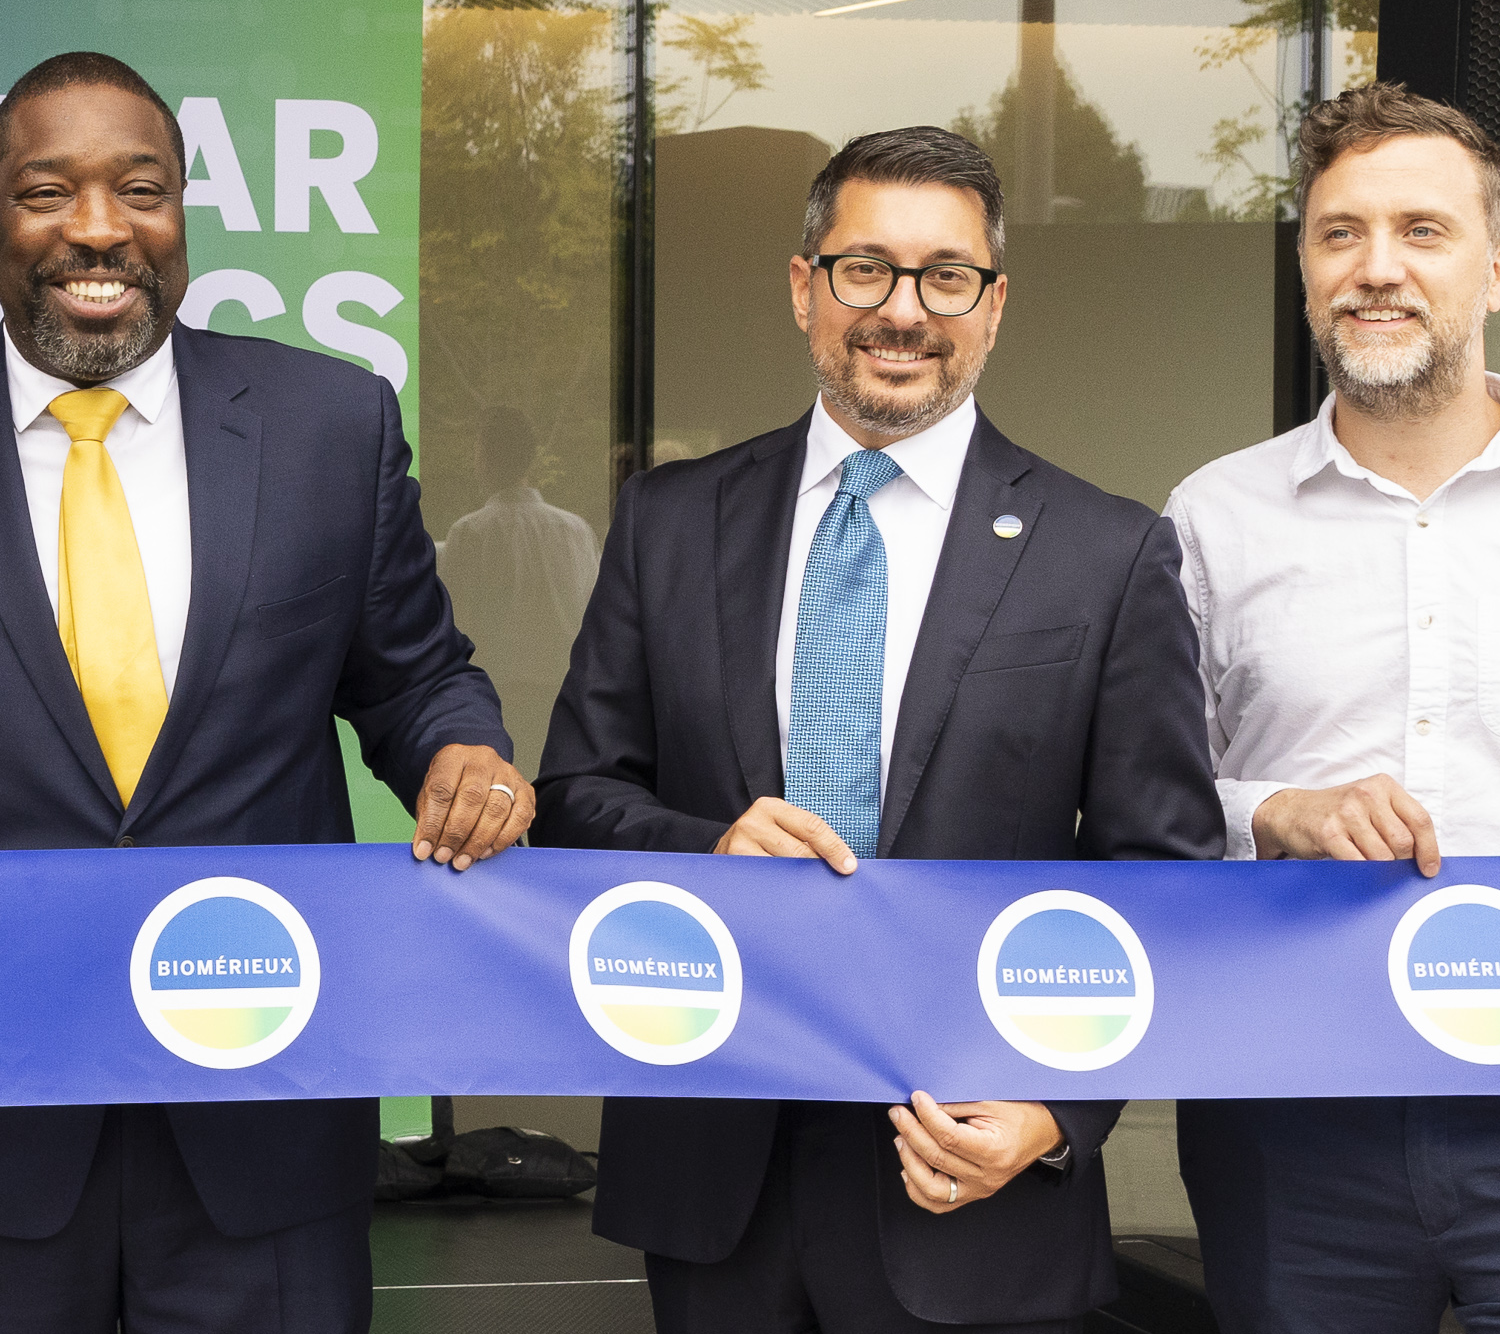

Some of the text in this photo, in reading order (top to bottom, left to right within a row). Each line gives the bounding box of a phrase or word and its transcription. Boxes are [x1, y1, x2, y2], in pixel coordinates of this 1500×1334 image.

[157, 957, 294, 977] BIOMÉRIEUX
[594, 957, 716, 980] BIOMÉRIEUX
[1002, 967, 1129, 985] BIOMÉRIEUX
